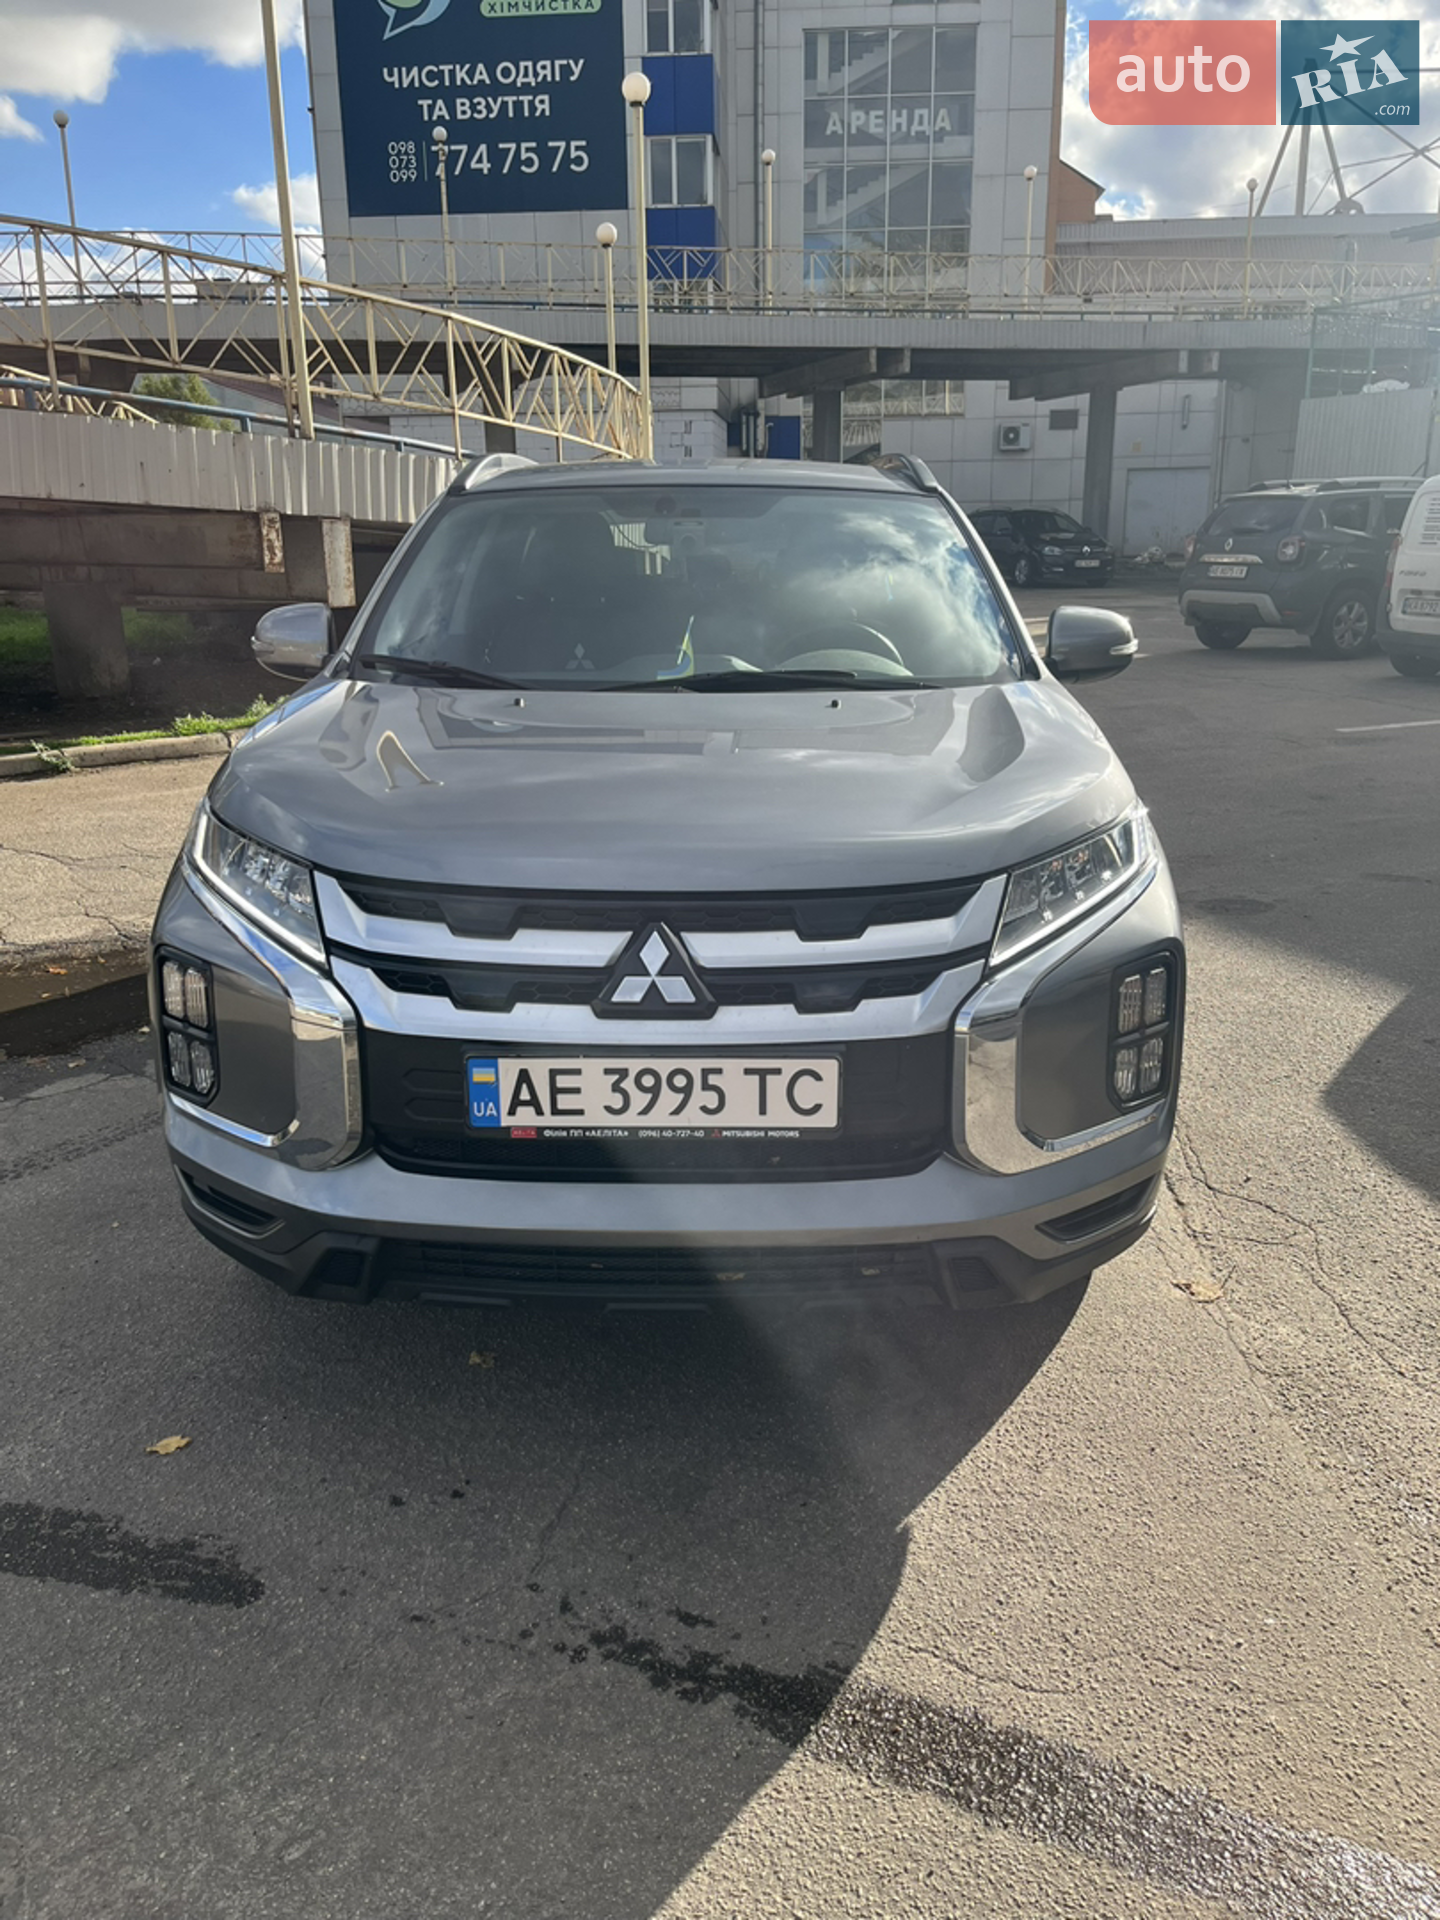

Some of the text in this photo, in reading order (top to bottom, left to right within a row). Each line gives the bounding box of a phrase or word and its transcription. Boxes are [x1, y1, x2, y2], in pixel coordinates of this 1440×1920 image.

[487, 0, 595, 14] ХІМЧИСТКА
[382, 58, 585, 88] ЧИСТКА ОДЯГУ
[417, 94, 551, 121] ТА ВЗУТТЯ
[825, 107, 952, 136] АРЕНДА
[388, 141, 416, 155] 098
[389, 156, 417, 168] 073
[498, 142, 540, 174] 75
[547, 140, 590, 173] 75
[390, 170, 418, 183] 099
[506, 1068, 824, 1117] AE 3995 TC
[473, 1102, 498, 1117] UA
[722, 1130, 800, 1138] MITSUBISHI MOTORS
